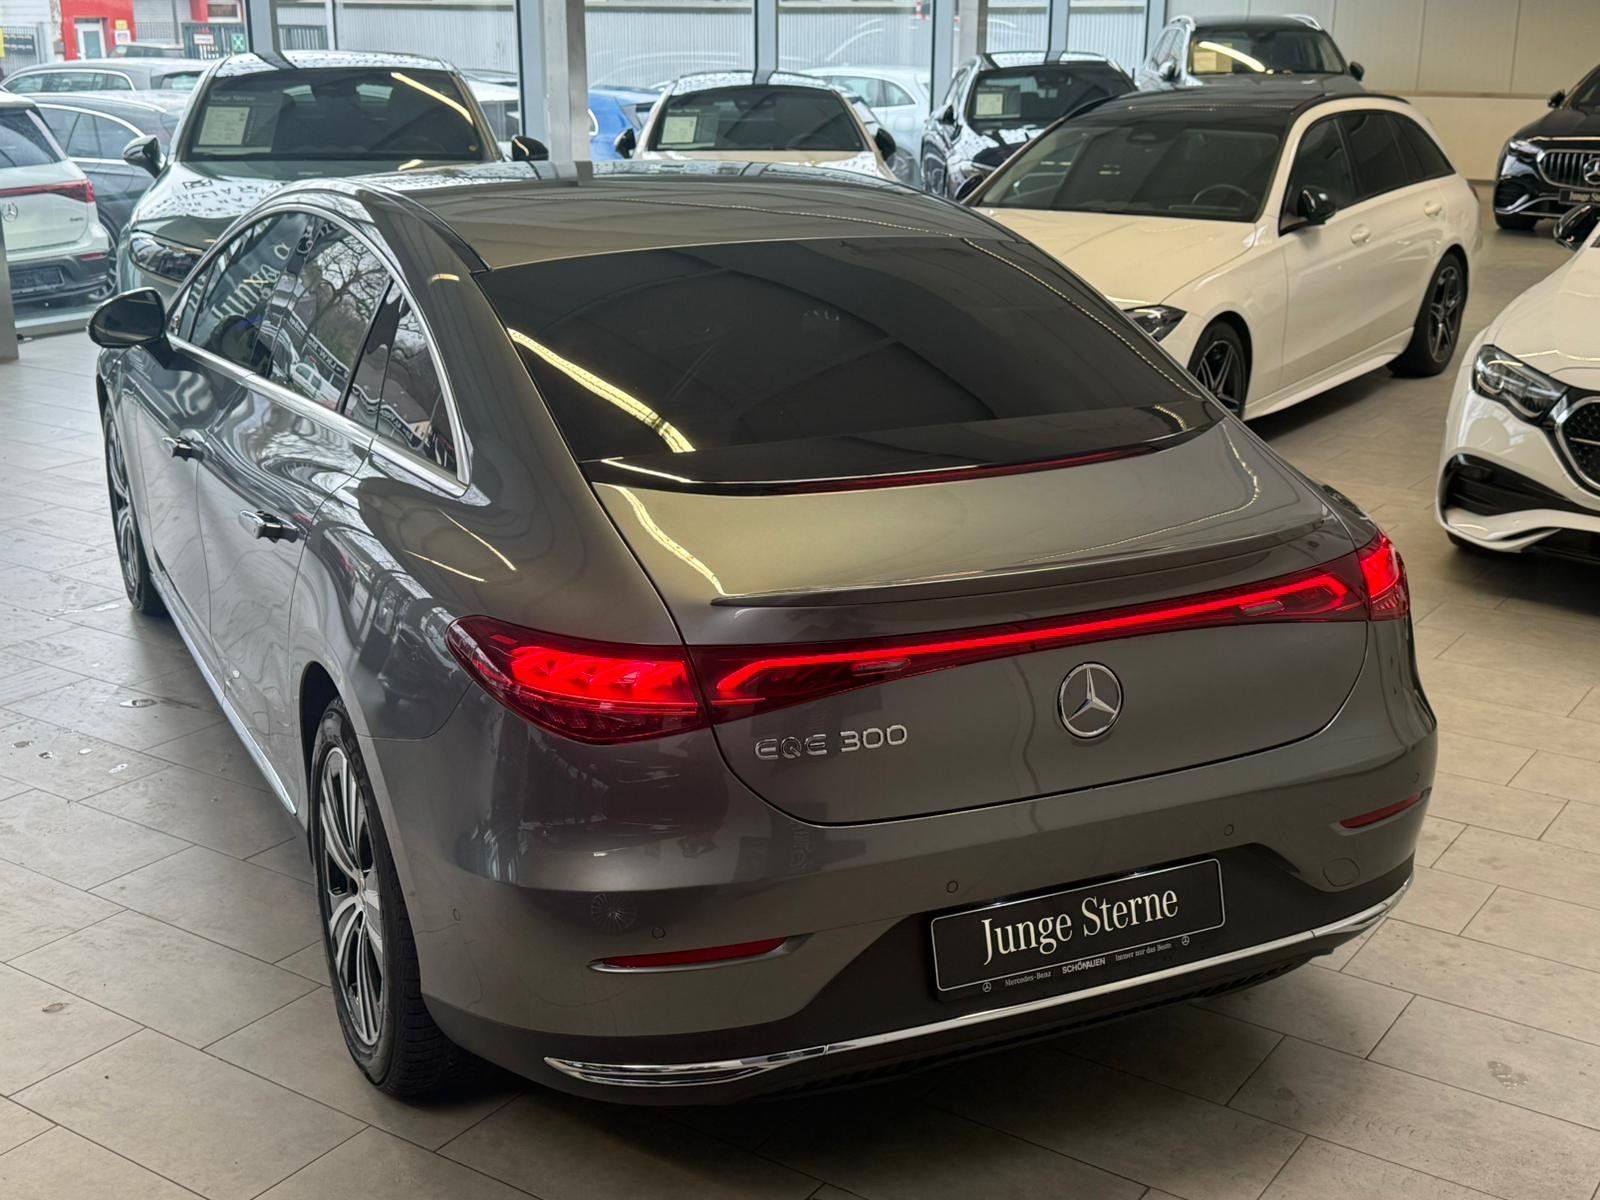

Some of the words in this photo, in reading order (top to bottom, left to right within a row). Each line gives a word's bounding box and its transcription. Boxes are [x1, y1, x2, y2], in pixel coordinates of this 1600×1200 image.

[755, 733, 827, 760] EQE
[840, 724, 908, 752] 300
[981, 913, 1073, 965] Junge
[1081, 889, 1178, 937] Sterne
[1005, 971, 1052, 987] Mercedes-Benz
